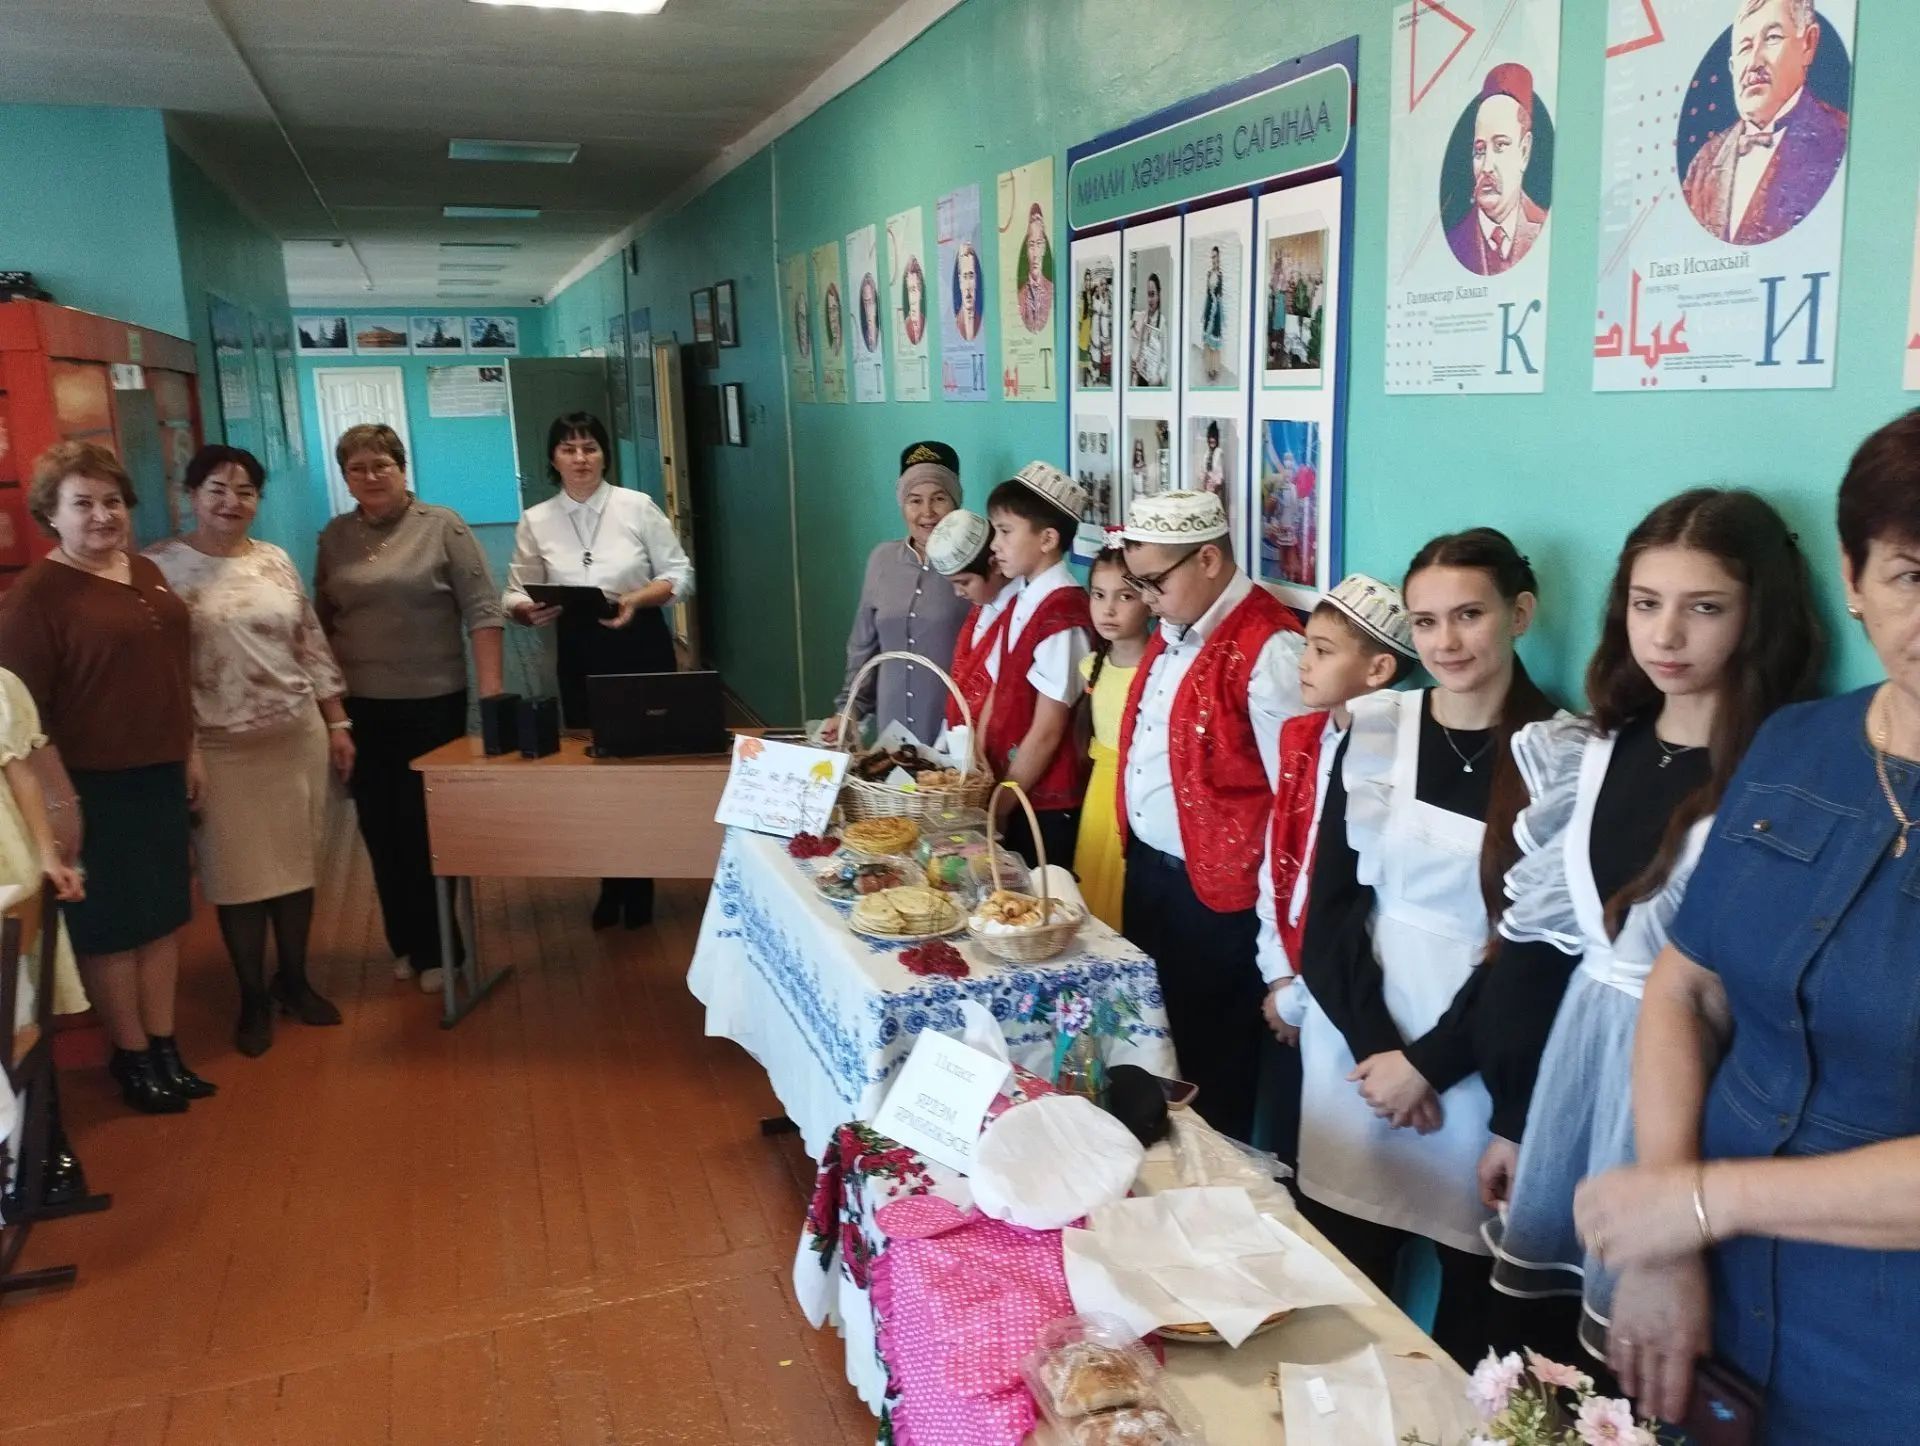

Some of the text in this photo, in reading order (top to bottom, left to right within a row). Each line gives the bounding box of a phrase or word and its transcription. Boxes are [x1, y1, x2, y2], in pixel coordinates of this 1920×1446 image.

[1233, 100, 1332, 160] САГЫНДА
[1683, 251, 1751, 274] Исхакый
[1495, 299, 1541, 375] К
[1755, 271, 1830, 366] И
